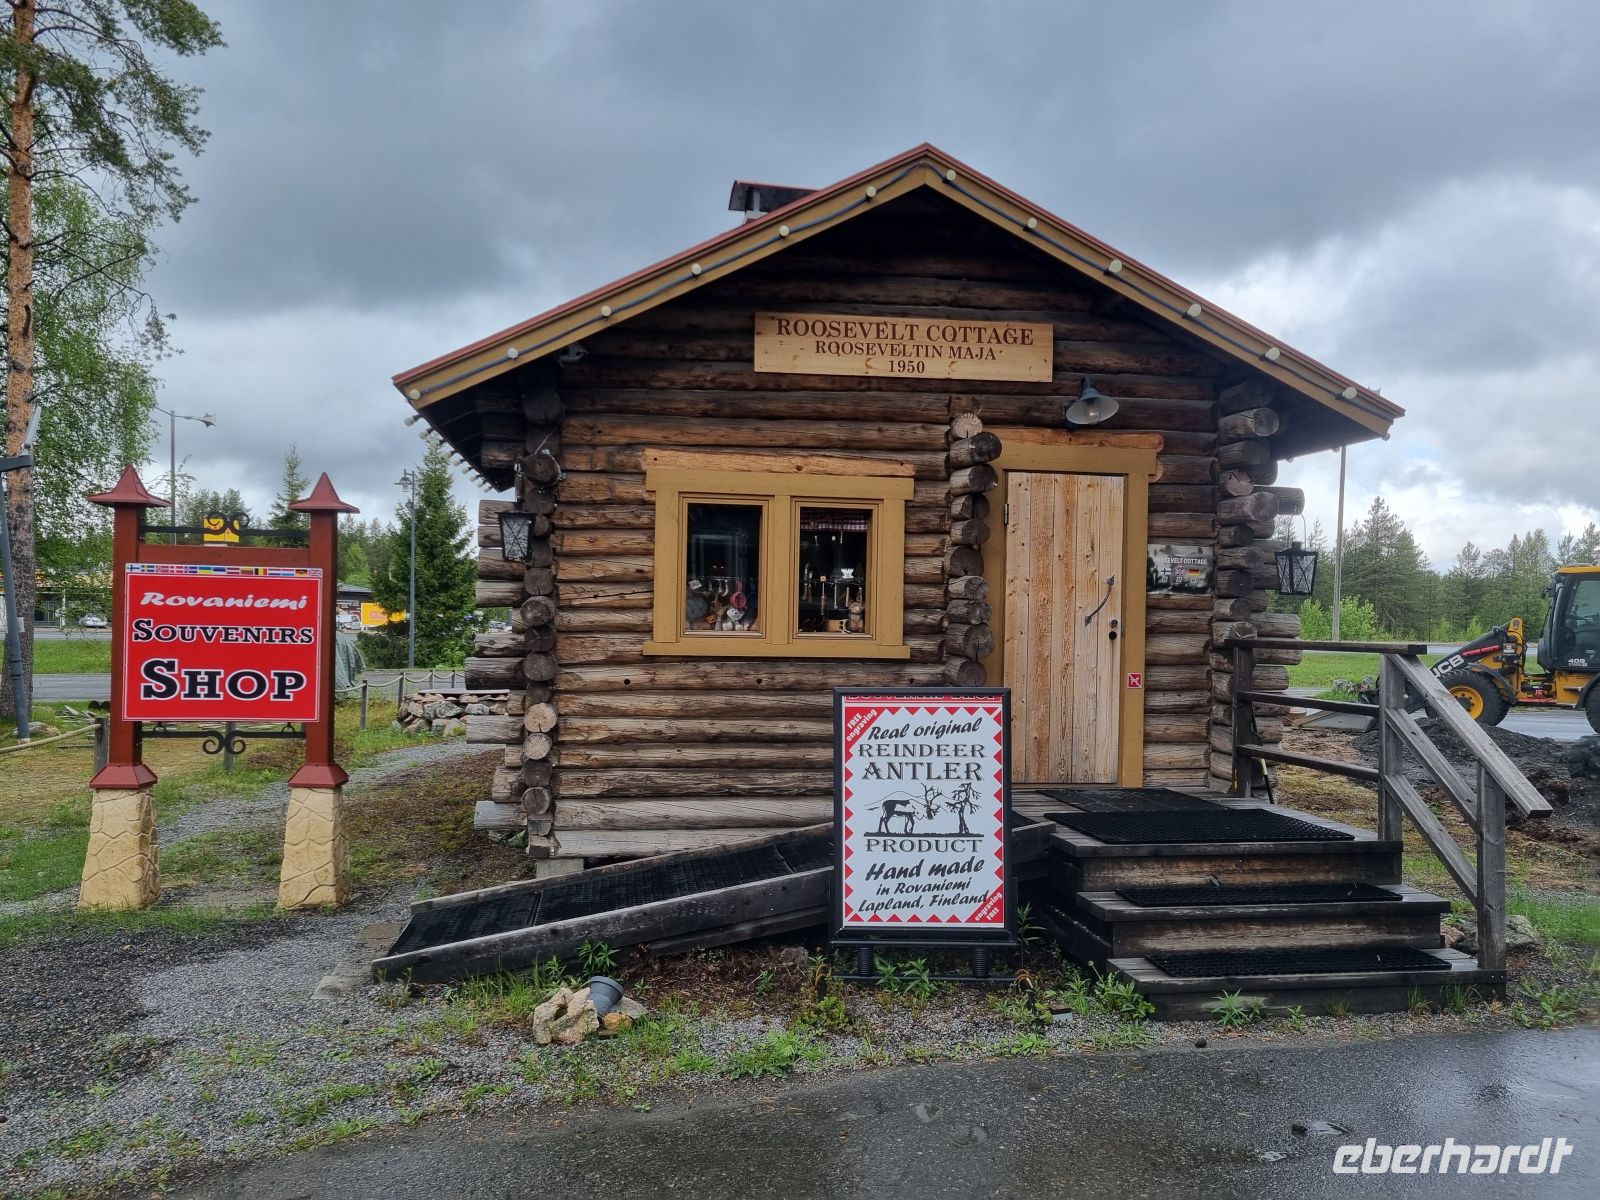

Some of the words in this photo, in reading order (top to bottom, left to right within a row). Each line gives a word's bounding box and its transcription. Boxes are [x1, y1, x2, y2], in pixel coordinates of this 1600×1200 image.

[776, 318, 919, 341] ROOSEVELT
[926, 324, 1034, 346] COTTAGE
[814, 340, 943, 359] ROOSEVELTIN
[949, 346, 997, 361] MAJA
[888, 359, 926, 374] 1950
[140, 591, 308, 611] Rovaniemi
[132, 618, 314, 645] SOUVENIRS
[140, 657, 307, 702] SHOP
[846, 709, 878, 741] engraving
[847, 712, 863, 730] FREE
[867, 723, 910, 741] Real
[913, 717, 983, 739] original
[858, 743, 986, 758] REINDEER
[860, 762, 985, 781] ANTLER
[865, 838, 983, 853] PRODUCT
[865, 858, 925, 881] Hand
[928, 856, 985, 878] made
[876, 884, 889, 896] in
[893, 877, 972, 895] Rovaniemi
[858, 898, 925, 914] Lapland,
[929, 889, 990, 908] Finland
[975, 892, 1003, 921] engraving
